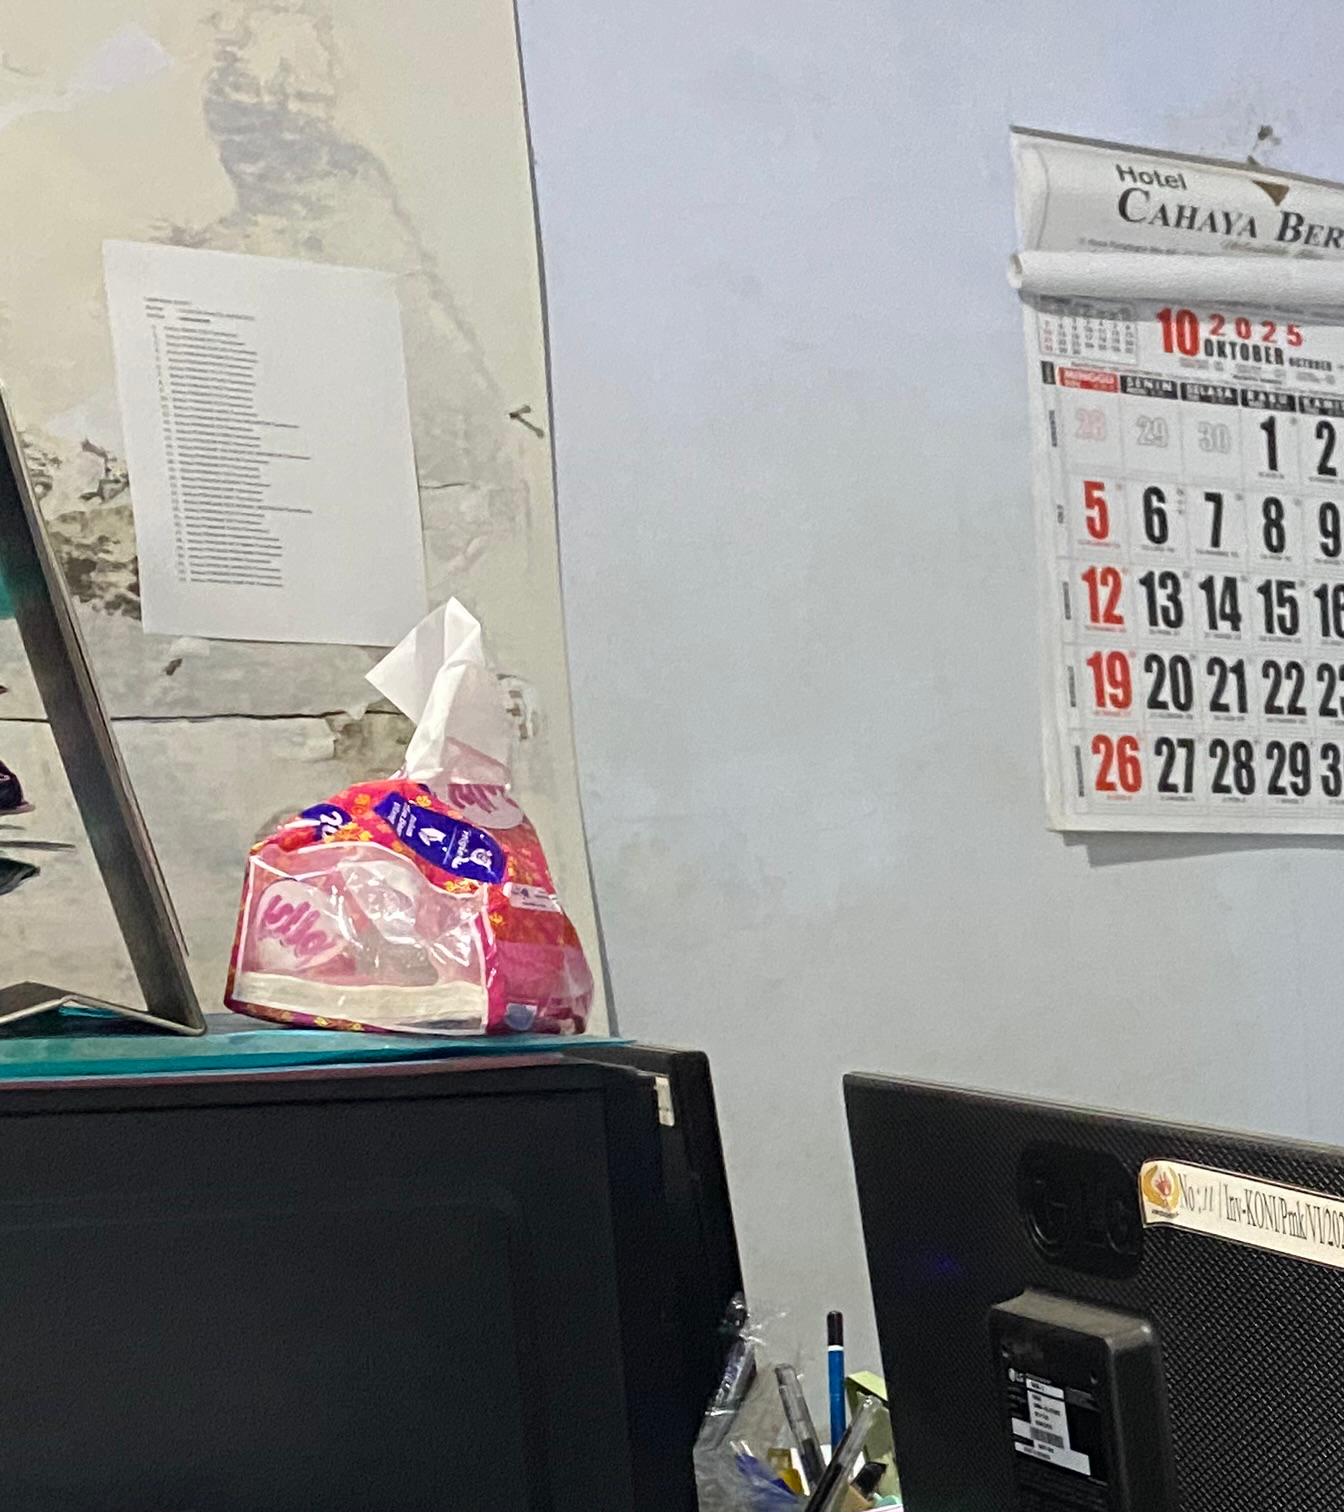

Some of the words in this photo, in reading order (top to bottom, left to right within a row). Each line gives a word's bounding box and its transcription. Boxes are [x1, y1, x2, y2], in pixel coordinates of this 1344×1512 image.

[1116, 164, 1187, 191] Hotel
[1117, 187, 1259, 239] CAHAYA
[1156, 307, 1200, 357] 10
[1209, 313, 1304, 347] 2025
[1204, 338, 1284, 366] OKTOBER
[1136, 414, 1169, 448] 29
[1198, 421, 1232, 453] 30
[1260, 415, 1278, 472] 1
[1315, 420, 1337, 477] 2
[1083, 480, 1110, 540] 5
[1142, 486, 1169, 545] 6
[1204, 492, 1223, 549] 7
[1262, 496, 1286, 554] 8
[1318, 501, 1342, 558] 9
[1081, 566, 1124, 625] 12
[1138, 570, 1184, 629] 13
[1198, 575, 1242, 632] 14
[1256, 579, 1300, 636] 15
[1086, 651, 1132, 709] 19
[1144, 653, 1194, 712] 20
[1206, 656, 1248, 714] 21
[1261, 659, 1307, 716] 22
[1091, 734, 1142, 793] 26
[1154, 736, 1195, 794] 27
[1208, 738, 1256, 796] 28
[1265, 740, 1311, 797] 29
